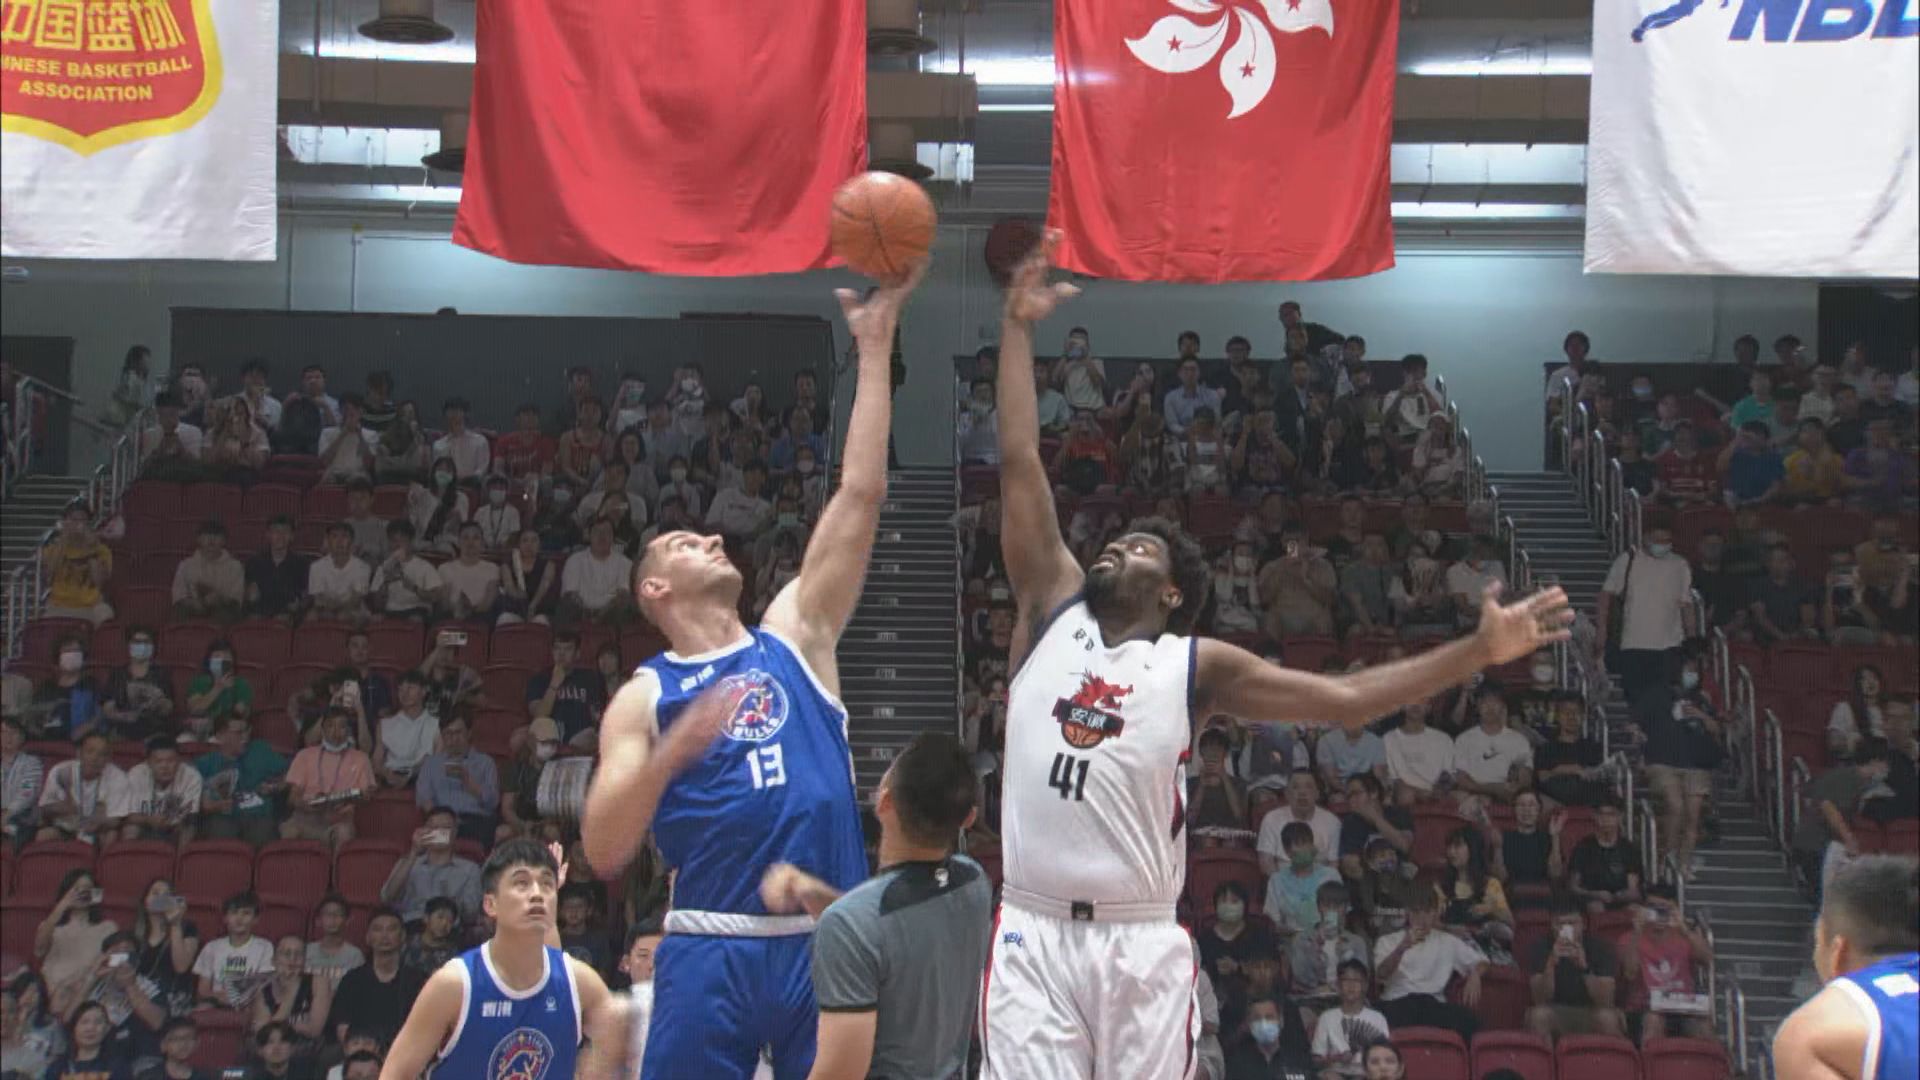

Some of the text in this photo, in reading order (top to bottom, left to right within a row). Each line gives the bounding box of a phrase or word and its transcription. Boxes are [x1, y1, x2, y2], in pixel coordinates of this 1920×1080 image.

[1728, 0, 1919, 42] NBL
[0, 55, 192, 78] INESE BASKETBALL
[19, 79, 153, 101] ASSOCIATION
[747, 743, 786, 789] 13
[1048, 752, 1090, 801] 41
